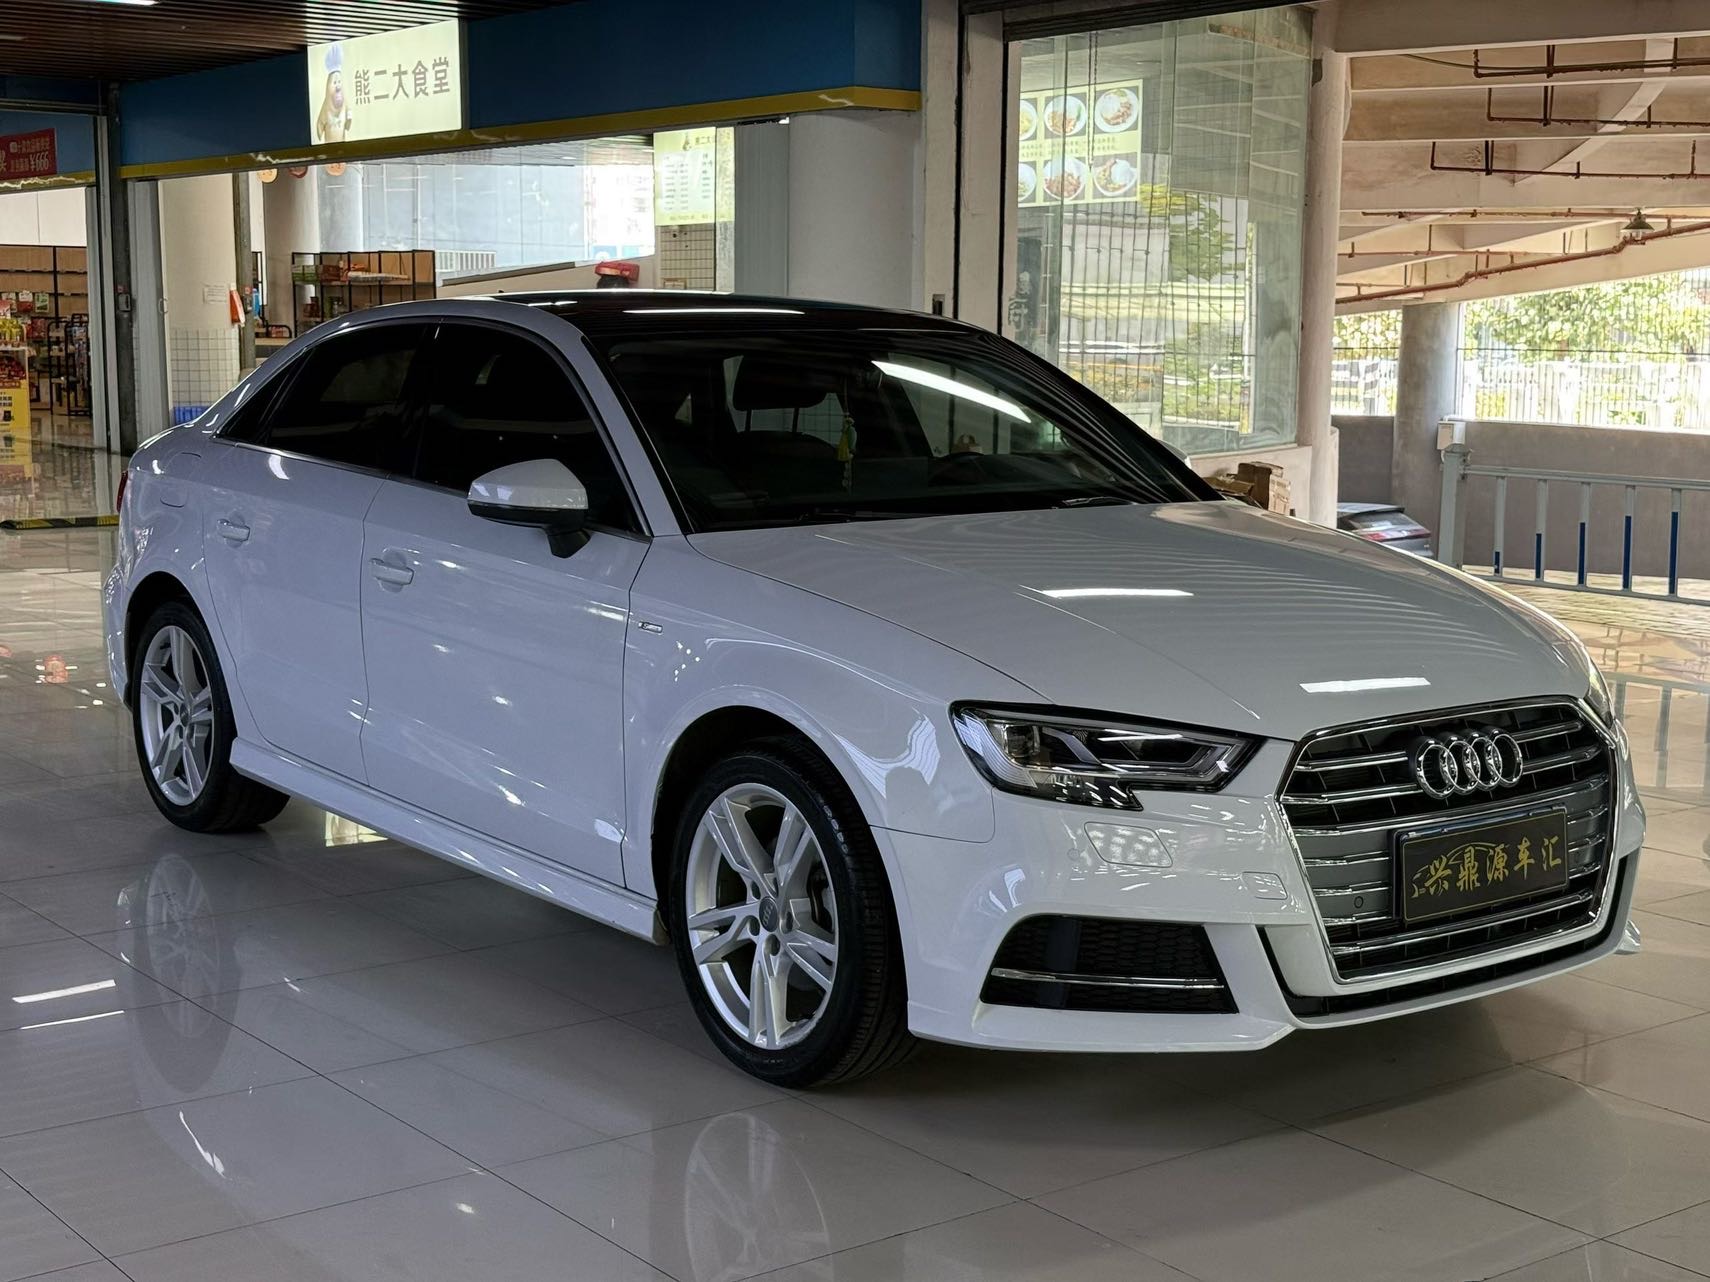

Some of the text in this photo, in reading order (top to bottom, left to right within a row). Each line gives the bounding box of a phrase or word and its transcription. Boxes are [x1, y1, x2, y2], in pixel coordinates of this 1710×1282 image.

[355, 57, 450, 104] 熊二大食堂
[1424, 836, 1562, 897] 兴鼎源车汇
